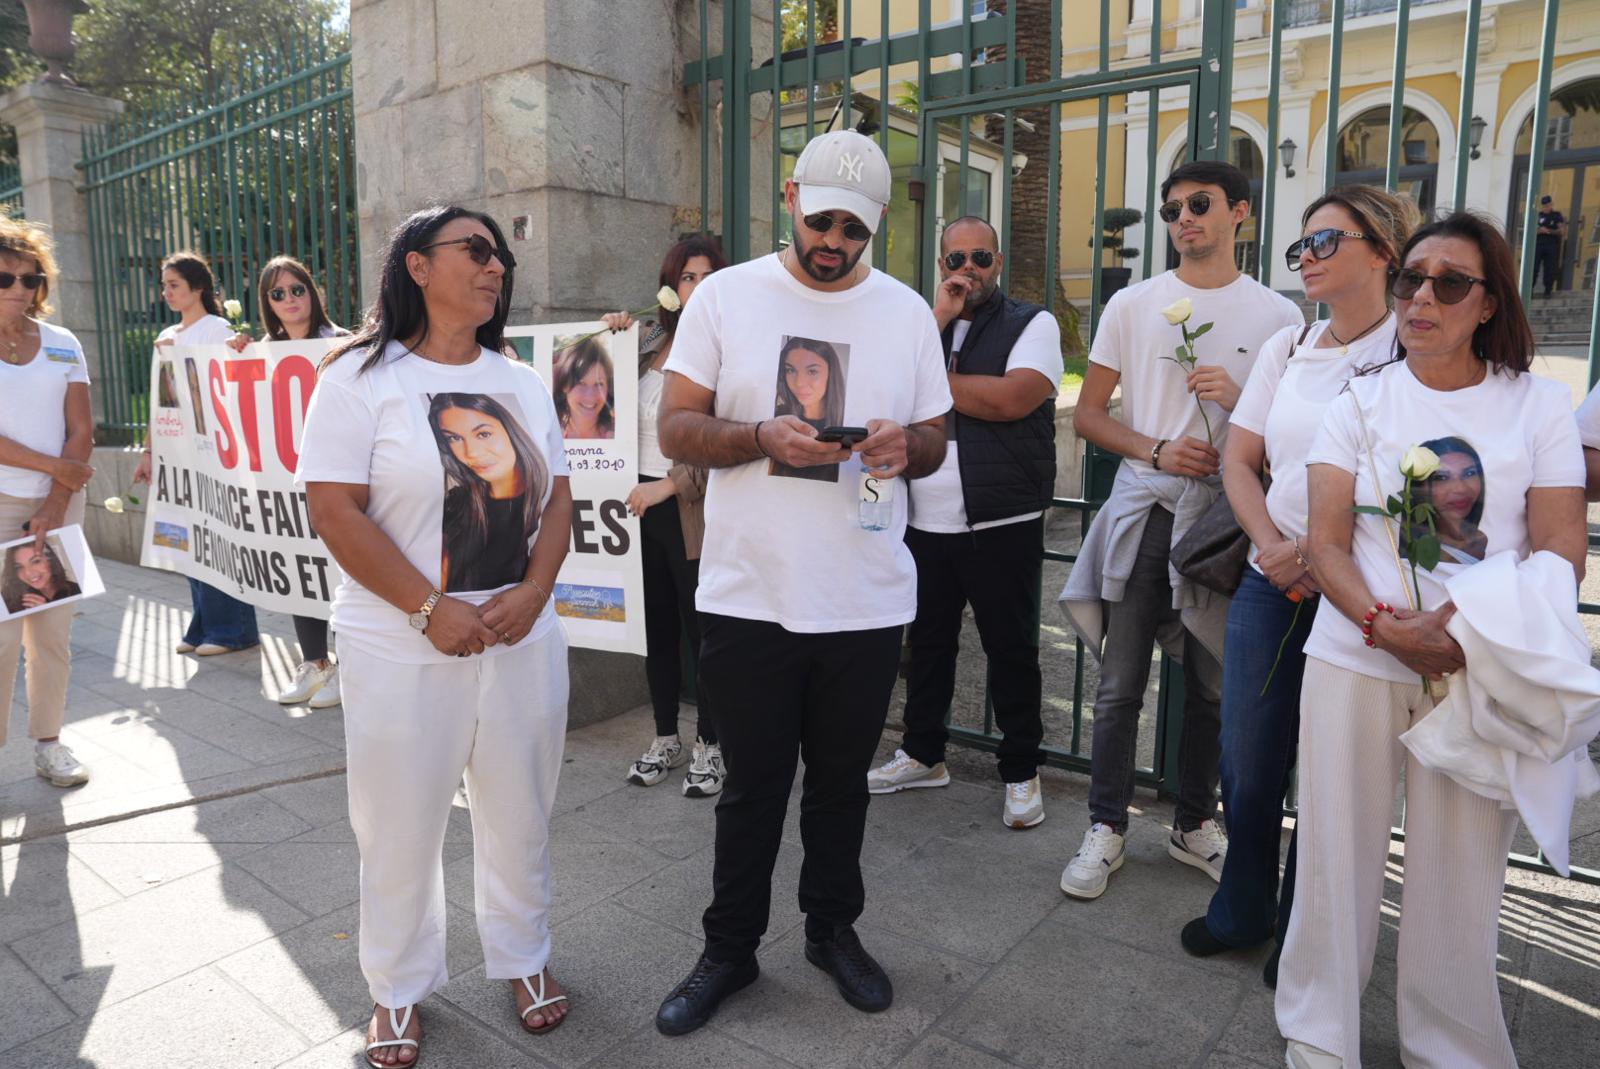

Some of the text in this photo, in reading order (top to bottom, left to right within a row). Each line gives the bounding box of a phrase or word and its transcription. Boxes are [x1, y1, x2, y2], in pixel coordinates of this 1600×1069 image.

[837, 152, 864, 183] NY
[157, 456, 169, 503] À
[173, 467, 193, 509] LA
[196, 471, 255, 533] VIOLENCE
[570, 499, 631, 556] ES
[193, 519, 331, 602] DÉNONÇONS ET
